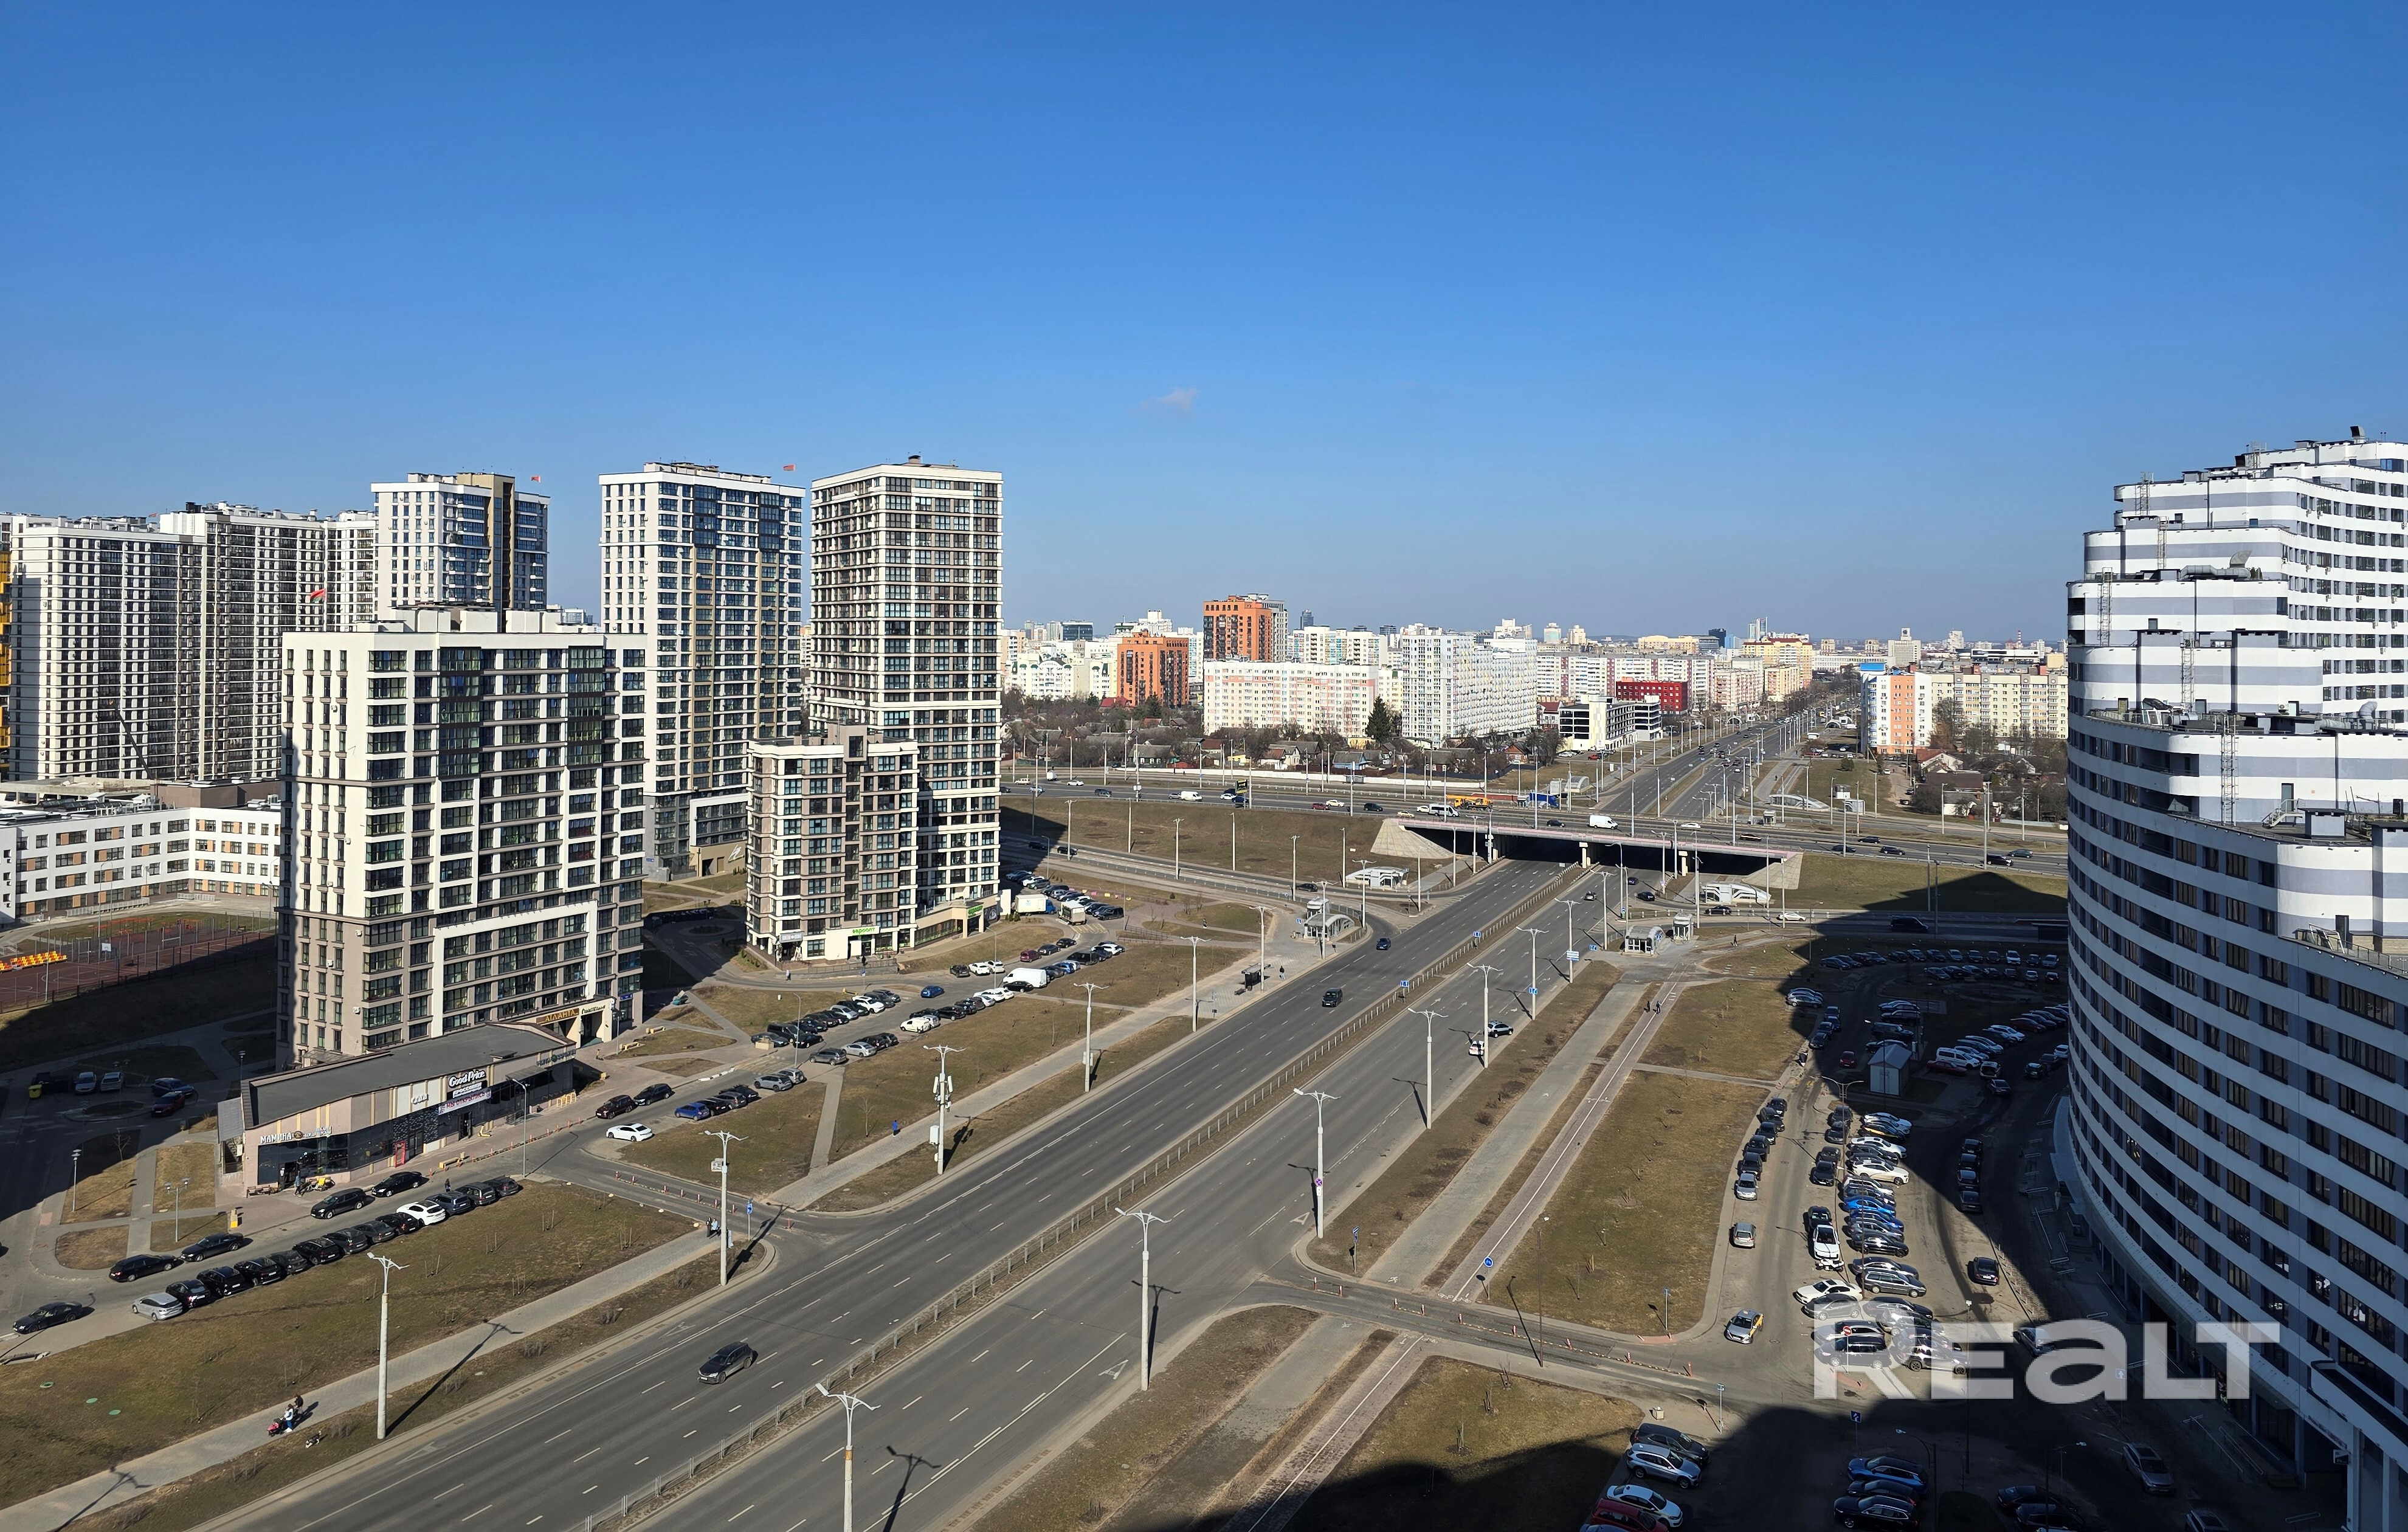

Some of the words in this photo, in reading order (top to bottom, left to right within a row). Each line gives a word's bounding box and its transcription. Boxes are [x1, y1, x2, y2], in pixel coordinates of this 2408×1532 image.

[449, 1074, 467, 1087] Good
[467, 1071, 486, 1082] Price
[260, 1132, 292, 1144] МАМИНА
